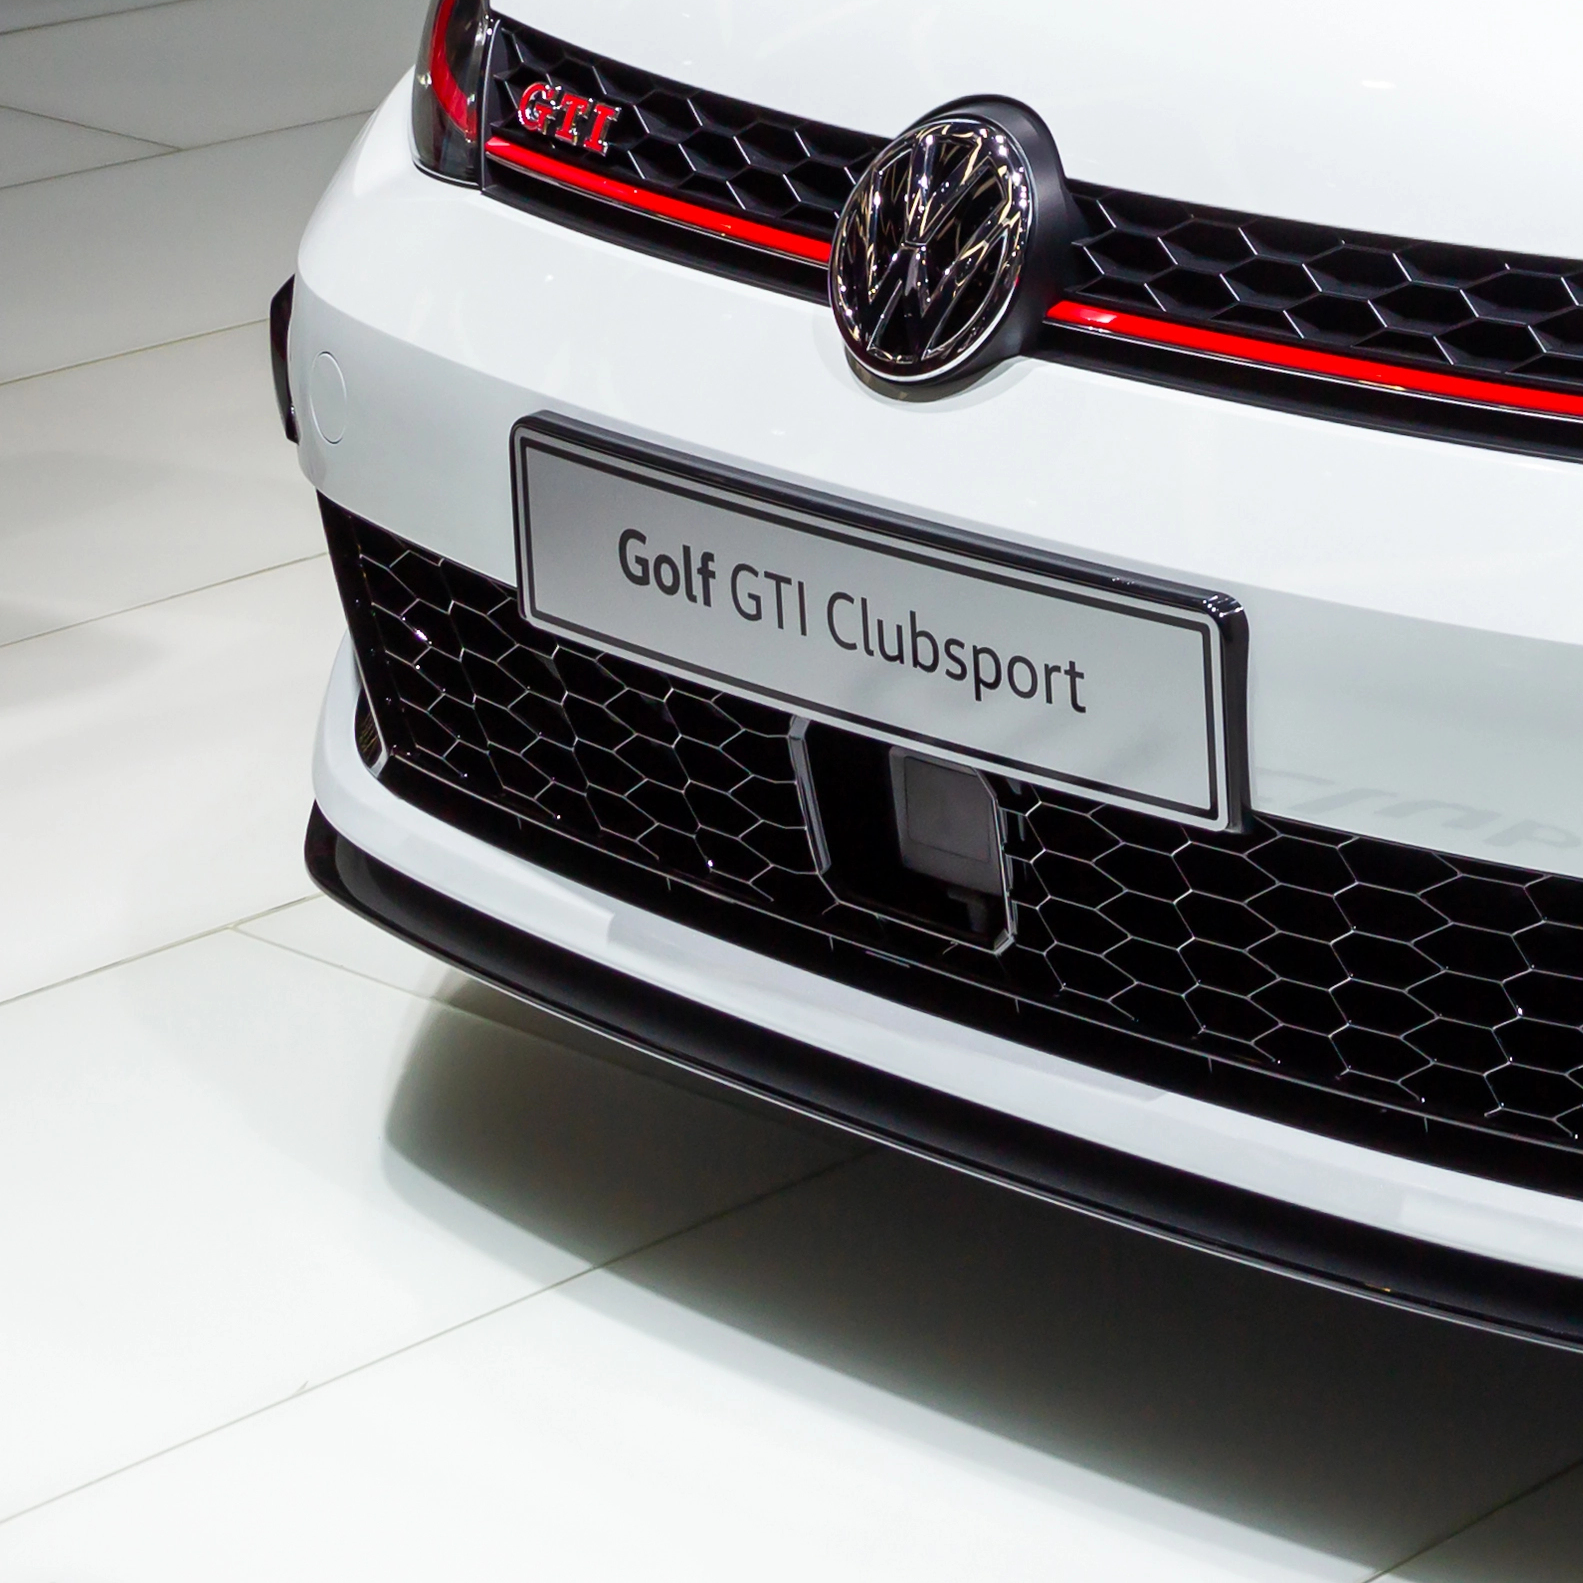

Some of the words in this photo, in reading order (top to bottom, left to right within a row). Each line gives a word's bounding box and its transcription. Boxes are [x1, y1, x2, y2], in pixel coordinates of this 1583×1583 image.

[518, 82, 621, 157] GTI
[618, 528, 716, 608] Golf
[730, 563, 808, 637] GTI
[826, 591, 1087, 714] Clubsport
